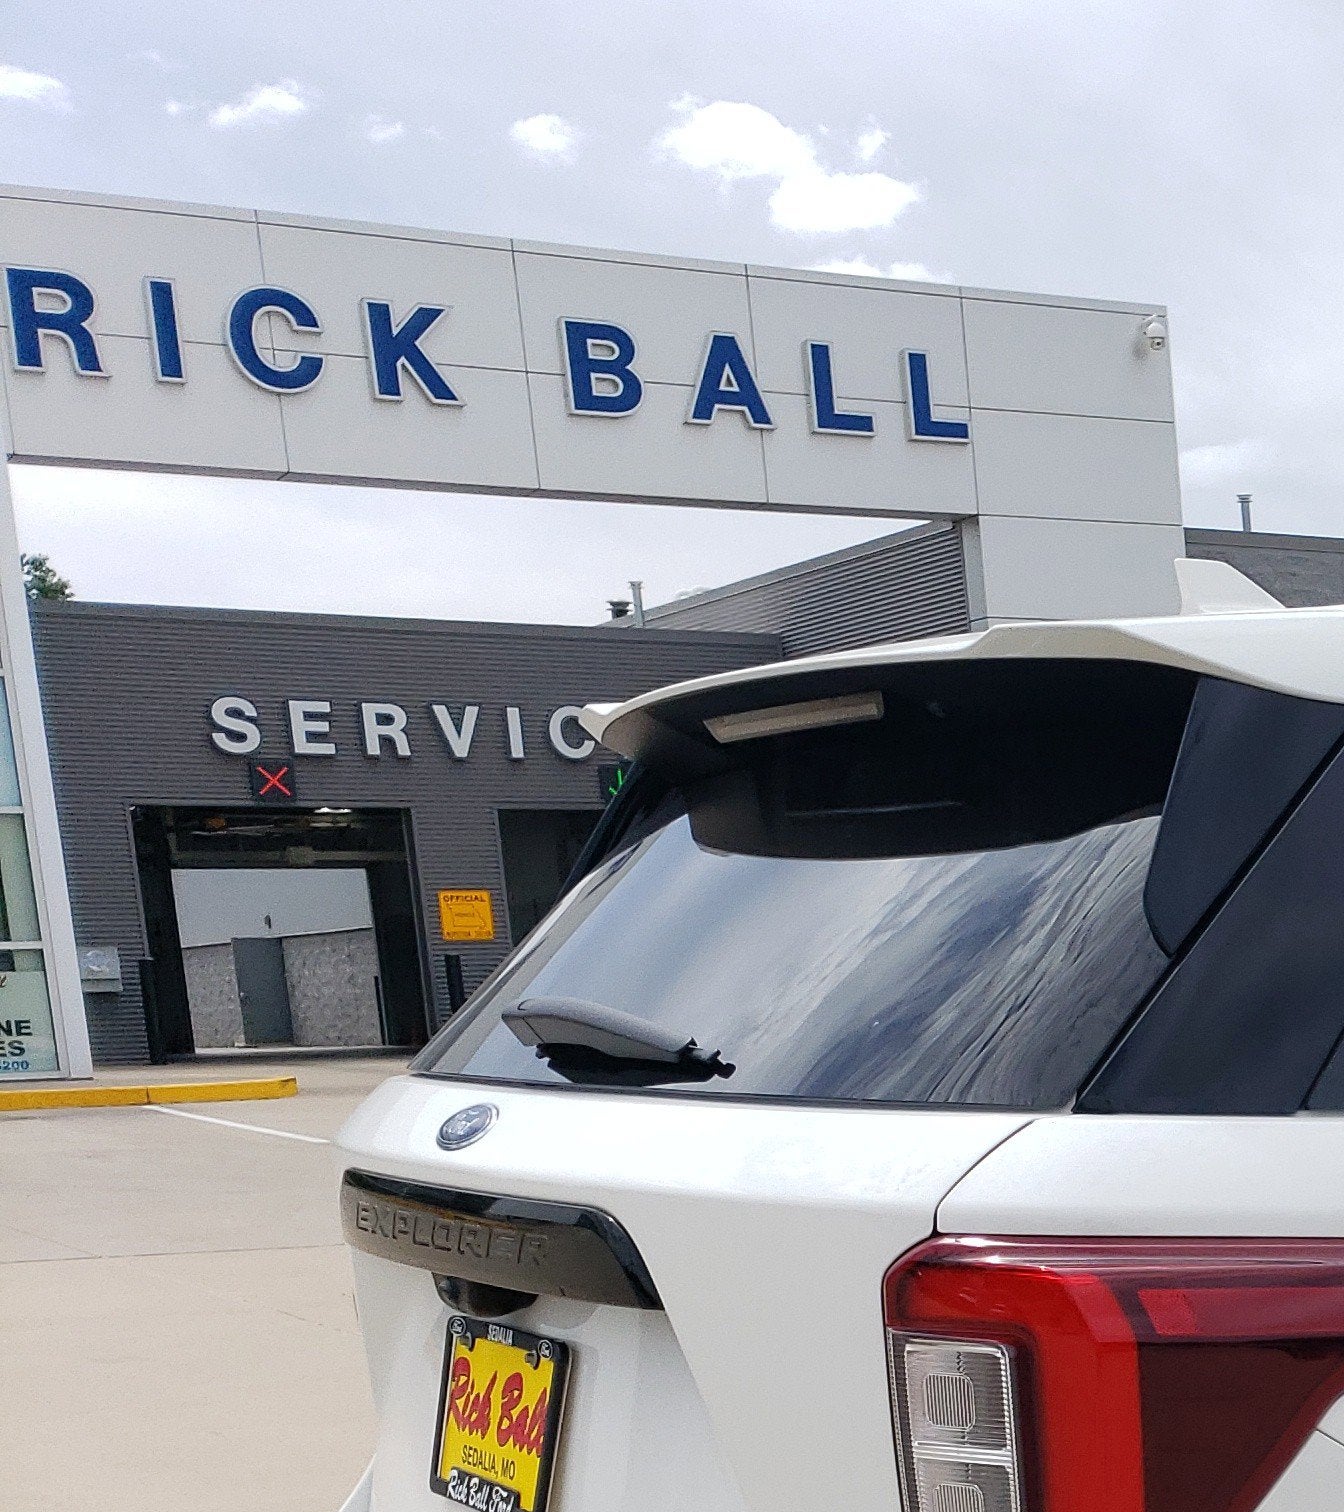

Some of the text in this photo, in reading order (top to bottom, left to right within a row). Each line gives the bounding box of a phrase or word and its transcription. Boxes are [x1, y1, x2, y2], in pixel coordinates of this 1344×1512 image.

[4, 265, 971, 443] RICK BALL
[443, 895, 486, 903] OFFICIAL
[356, 1200, 549, 1265] EXPLORER
[448, 1356, 548, 1459] Rick Ball
[446, 1468, 470, 1504] Rick
[468, 1476, 490, 1512] Ball
[501, 1456, 516, 1481] MO
